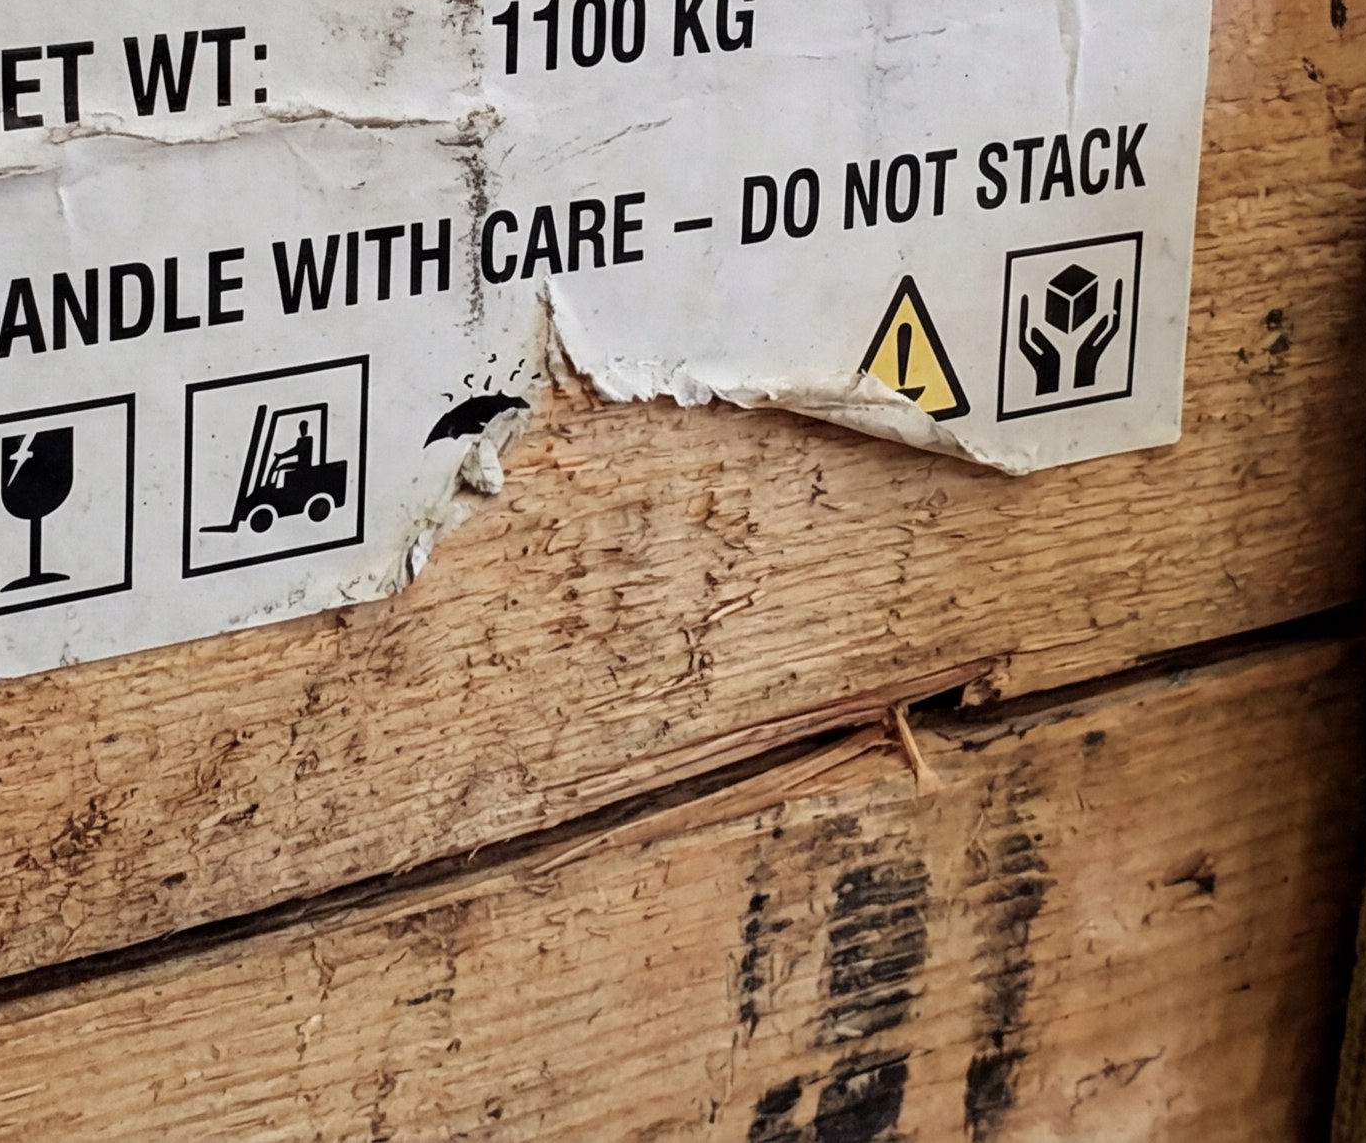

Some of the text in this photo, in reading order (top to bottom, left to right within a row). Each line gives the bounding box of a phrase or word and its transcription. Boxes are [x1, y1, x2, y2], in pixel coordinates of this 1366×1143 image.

[123, 26, 268, 117] WT:
[272, 218, 451, 315] WITH
[480, 191, 646, 285] CARE
[740, 167, 820, 246] DO
[843, 148, 958, 231] NOT
[976, 122, 1149, 210] STACK
